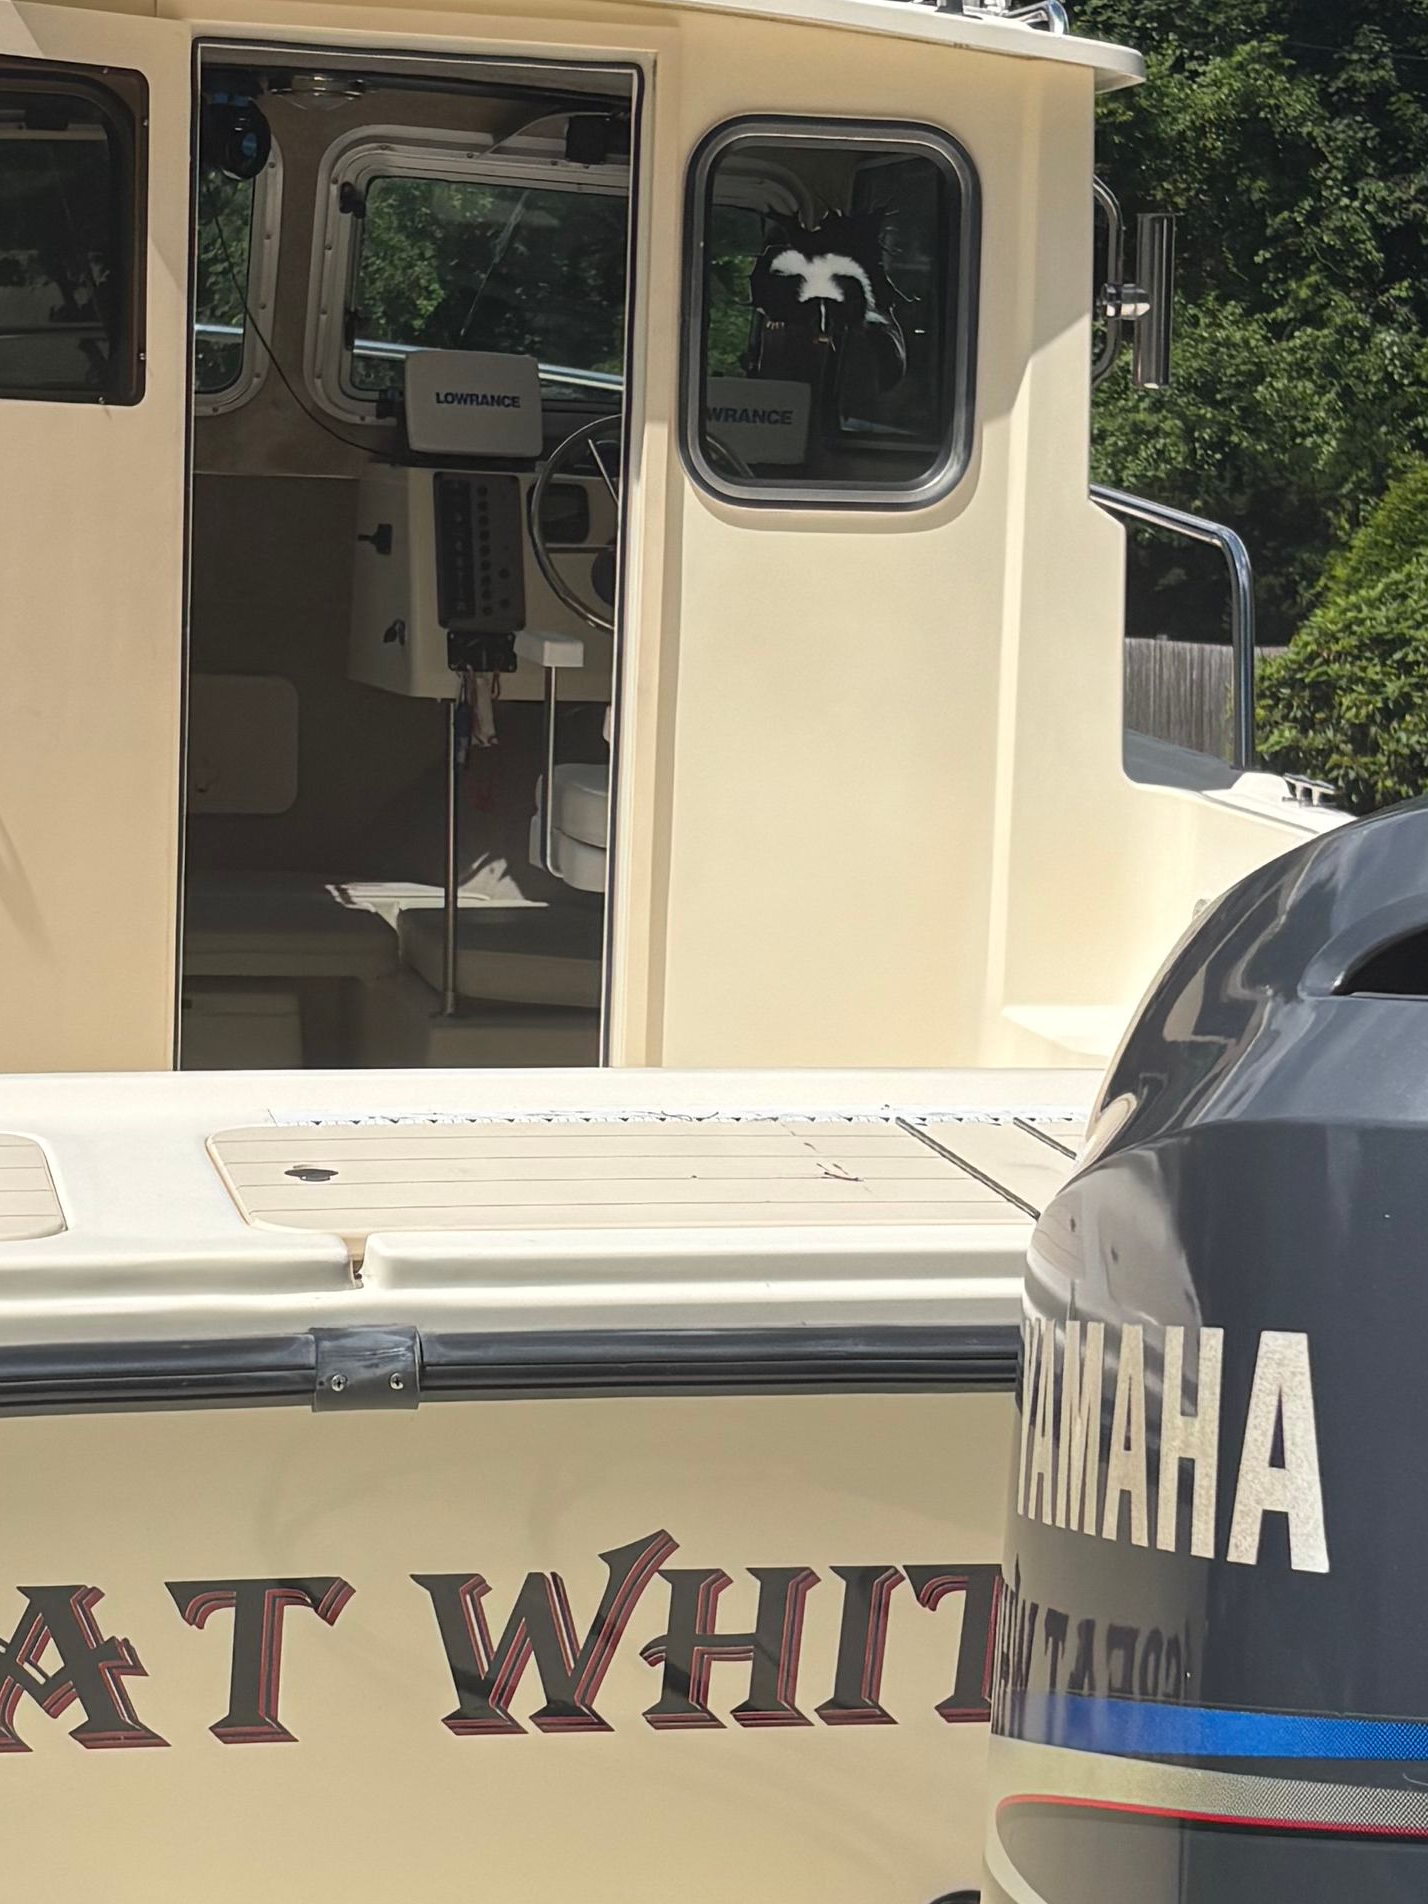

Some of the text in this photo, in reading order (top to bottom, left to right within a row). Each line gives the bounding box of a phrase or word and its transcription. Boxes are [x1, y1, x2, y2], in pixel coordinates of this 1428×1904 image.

[435, 392, 521, 408] LOWRANCE
[706, 407, 794, 425] WRANCE
[1018, 1318, 1330, 1573] YAMAHA
[411, 1530, 1004, 1735] WHIT
